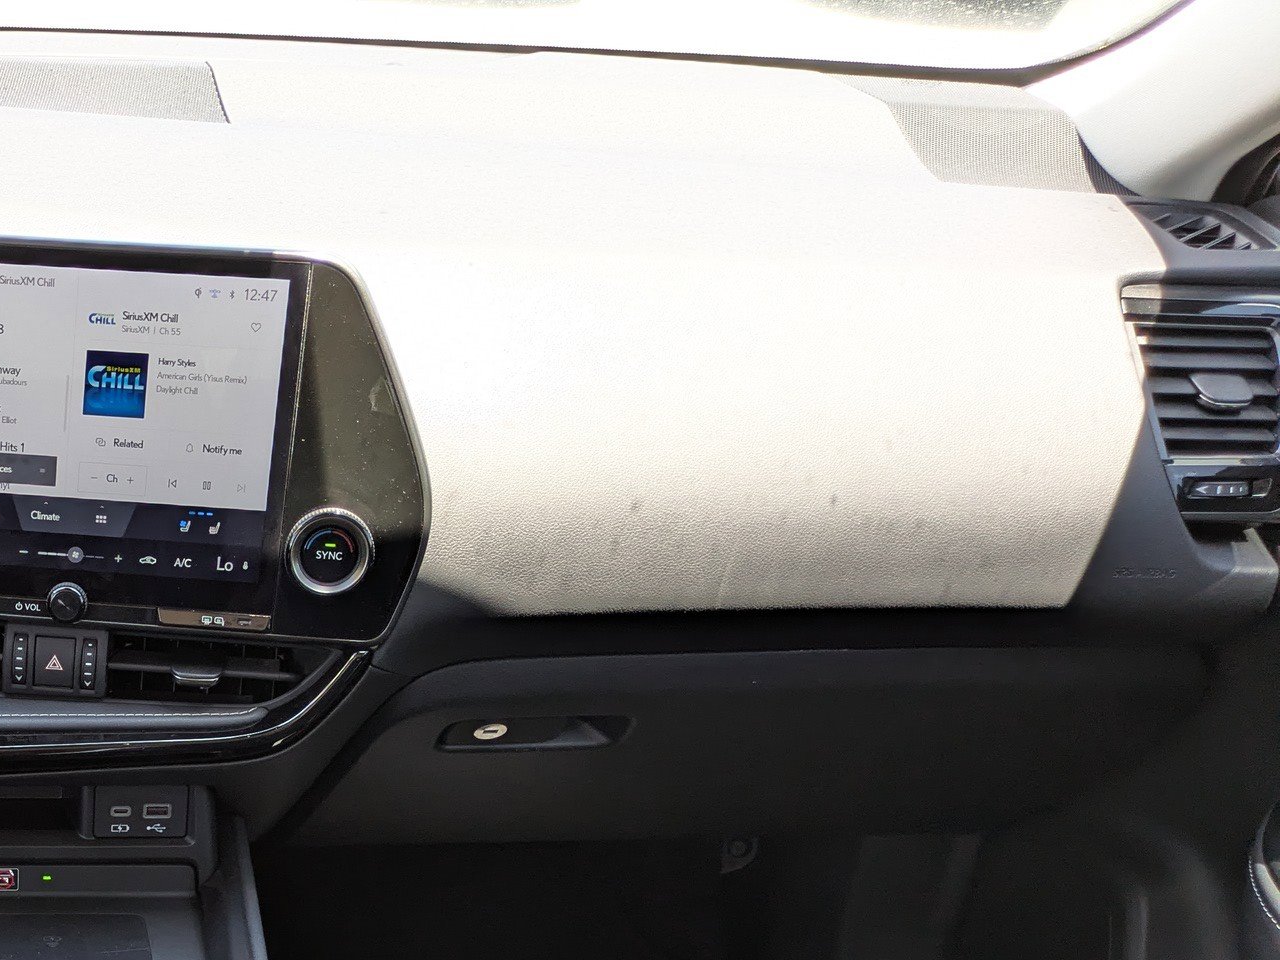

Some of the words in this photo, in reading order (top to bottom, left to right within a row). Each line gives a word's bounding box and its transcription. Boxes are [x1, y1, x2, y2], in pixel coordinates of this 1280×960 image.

[0, 275, 35, 286] SiriusXM
[37, 277, 55, 287] Chill
[244, 289, 278, 301] 12:47
[88, 312, 116, 325] CHILL
[122, 311, 158, 322] SiriusXM
[160, 312, 179, 323] Chill
[121, 325, 150, 334] SiriusXM
[159, 326, 169, 335] Ch
[171, 327, 181, 336] 55
[158, 358, 176, 367] Harry
[177, 359, 196, 369] Styles
[106, 366, 141, 374] SiriusXM
[87, 365, 144, 390] CHILL
[157, 372, 187, 381] American
[189, 373, 203, 382] Girls
[224, 375, 248, 385] Remix)
[156, 385, 182, 395] Daylight
[184, 386, 199, 395] Chill
[0, 442, 18, 452] Hits
[21, 443, 25, 453] 1
[113, 438, 144, 449] Related
[202, 444, 228, 456] Notify
[229, 448, 242, 456] me
[106, 473, 118, 483] Ch
[30, 510, 60, 522] Climate
[315, 550, 343, 561] SYNC
[173, 557, 192, 568] A/C
[216, 556, 234, 572] Lo
[24, 603, 41, 612] VOL
